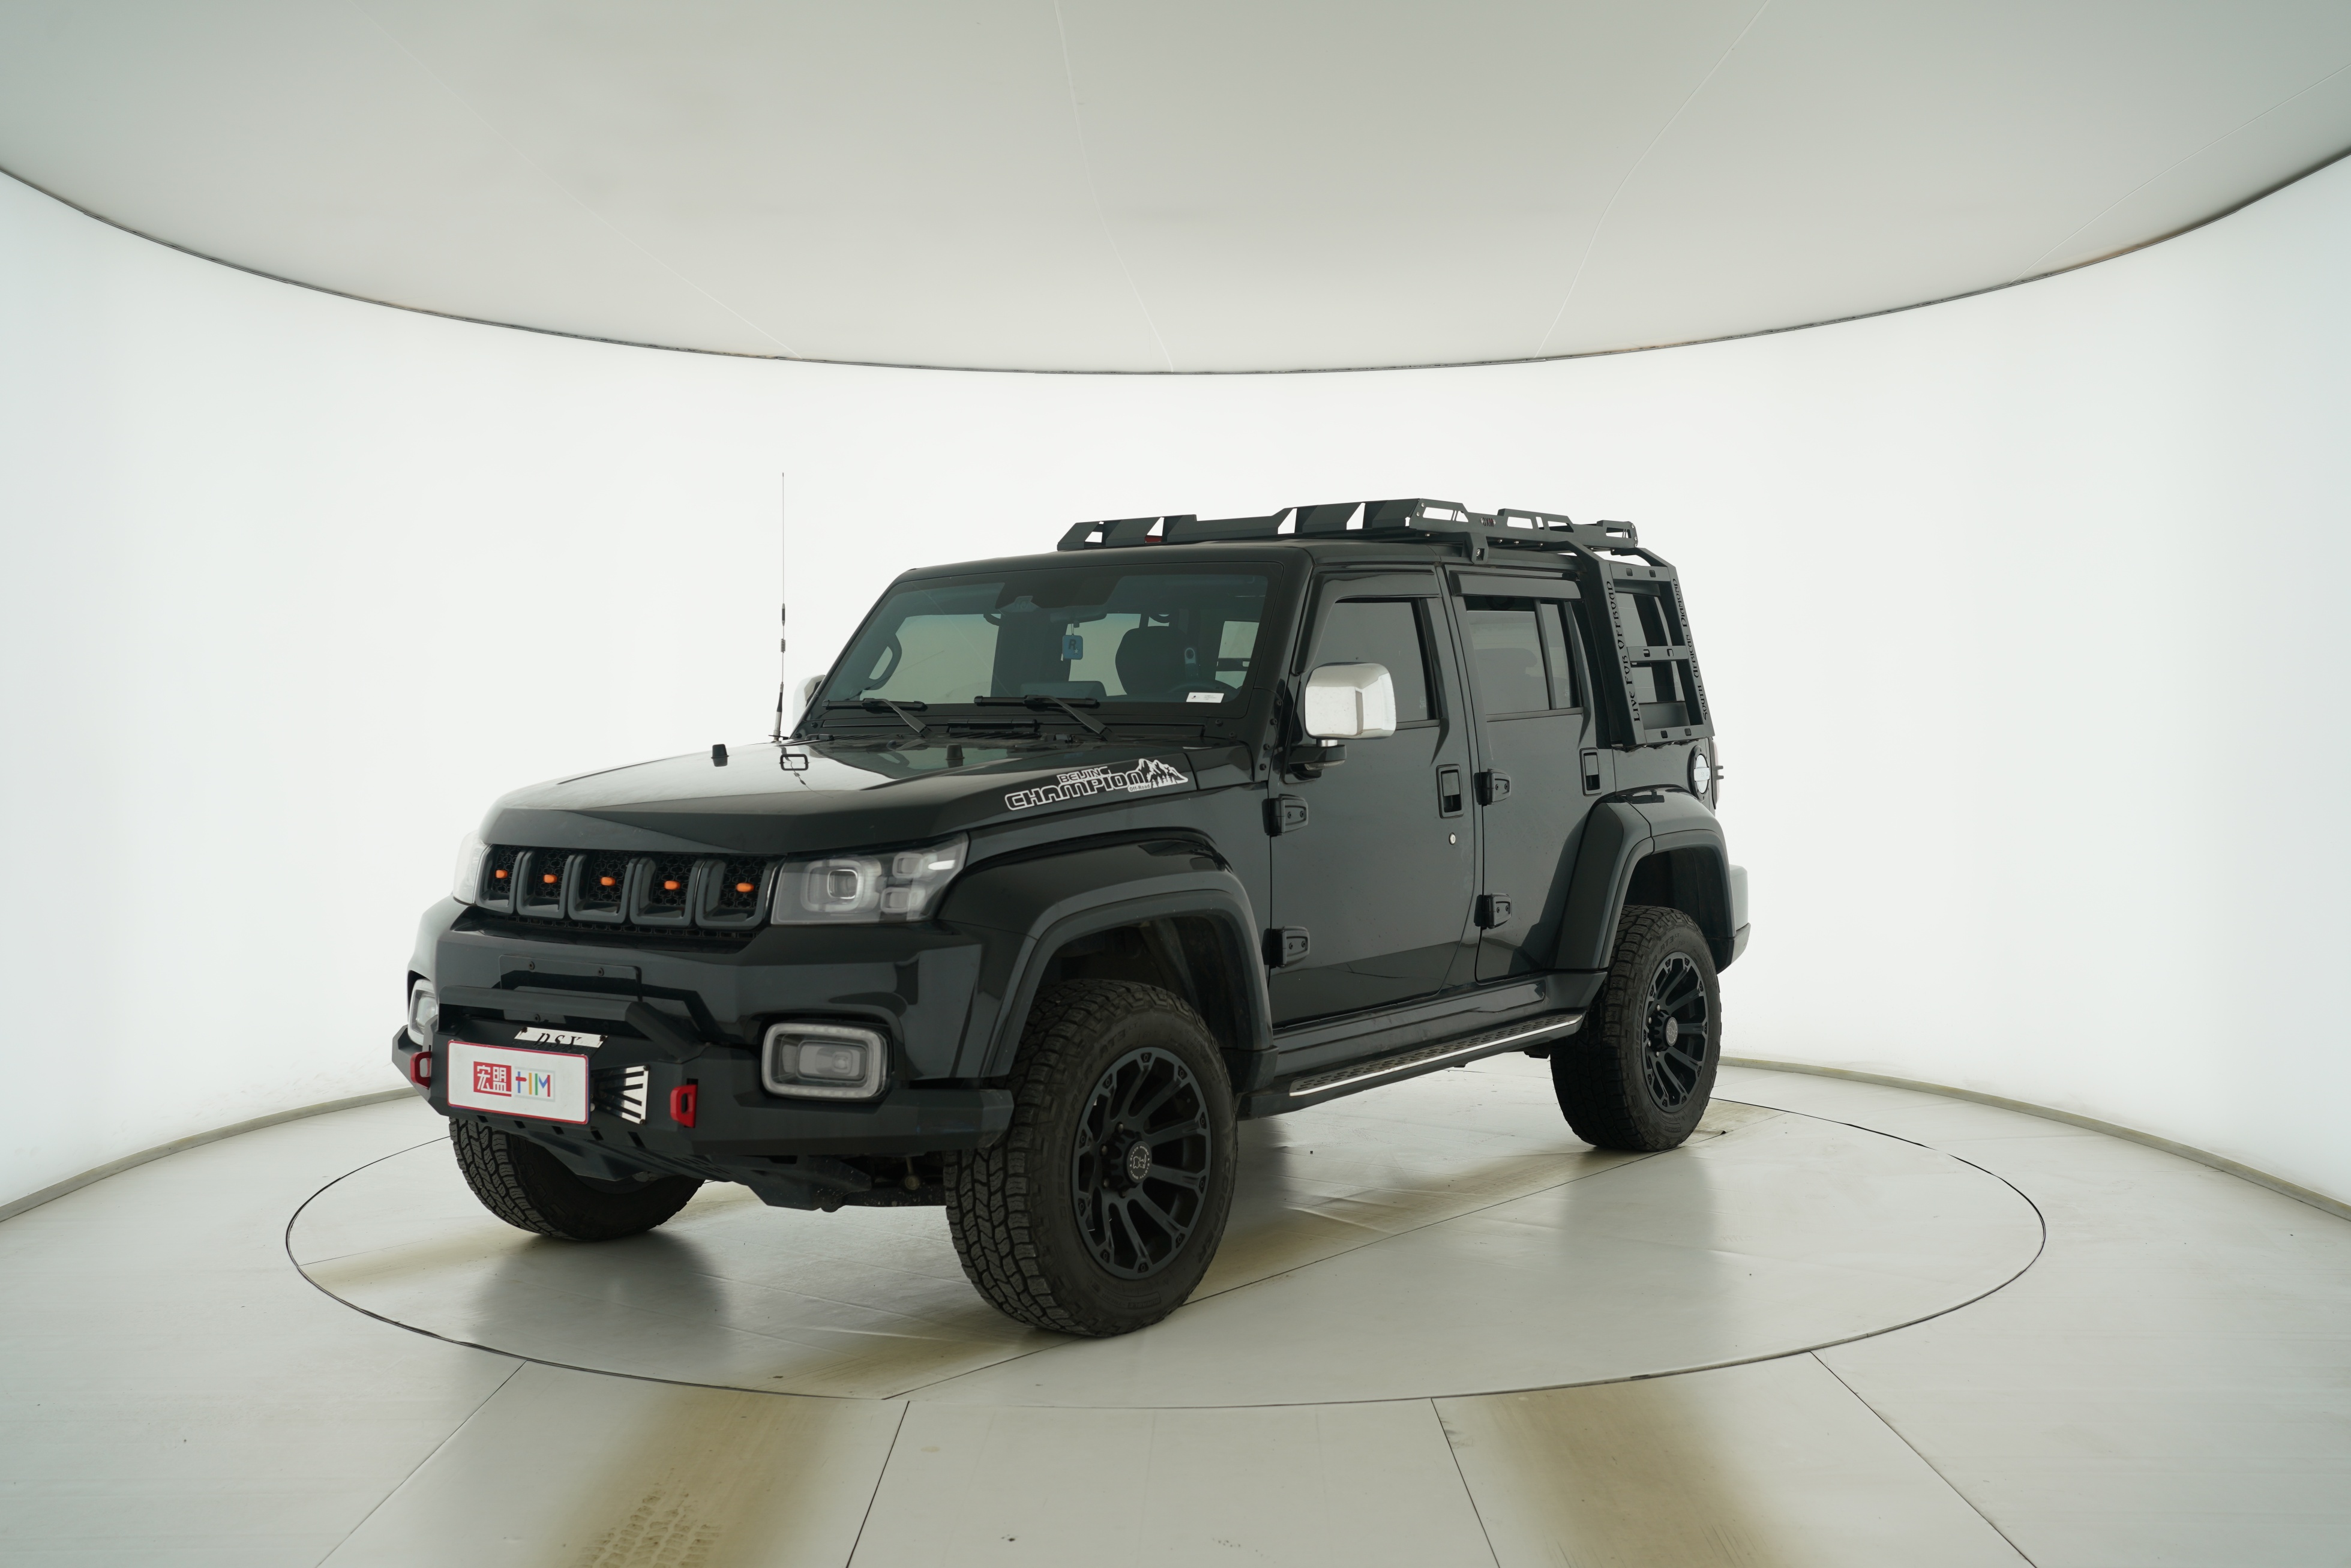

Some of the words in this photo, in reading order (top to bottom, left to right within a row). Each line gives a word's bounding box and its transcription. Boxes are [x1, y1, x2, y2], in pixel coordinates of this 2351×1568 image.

[1069, 639, 1076, 650] R
[1004, 770, 1147, 811] CHAMPION
[476, 1065, 510, 1093] 宏盟
